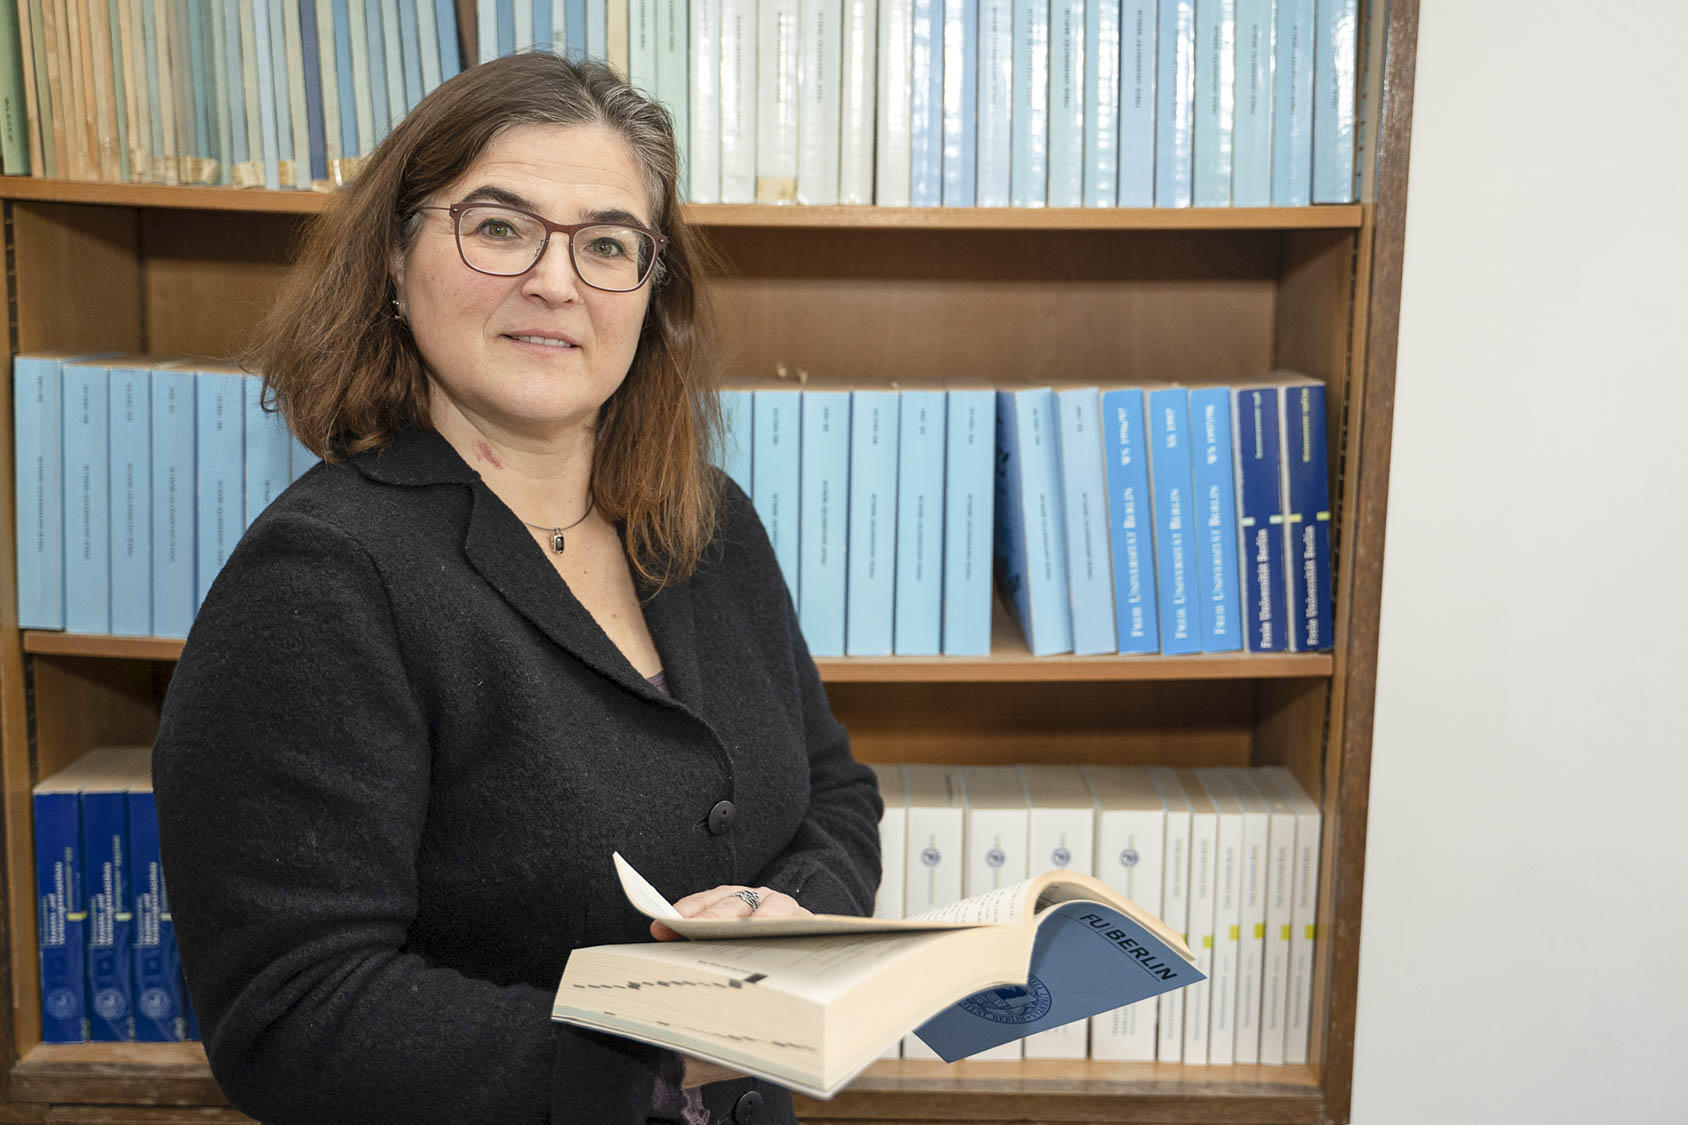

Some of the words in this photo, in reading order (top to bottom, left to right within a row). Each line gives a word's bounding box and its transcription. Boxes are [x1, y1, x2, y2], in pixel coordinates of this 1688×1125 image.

[1256, 528, 1269, 561] Berlin
[1303, 525, 1316, 558] Berlin
[1105, 928, 1178, 982] BERLIN
